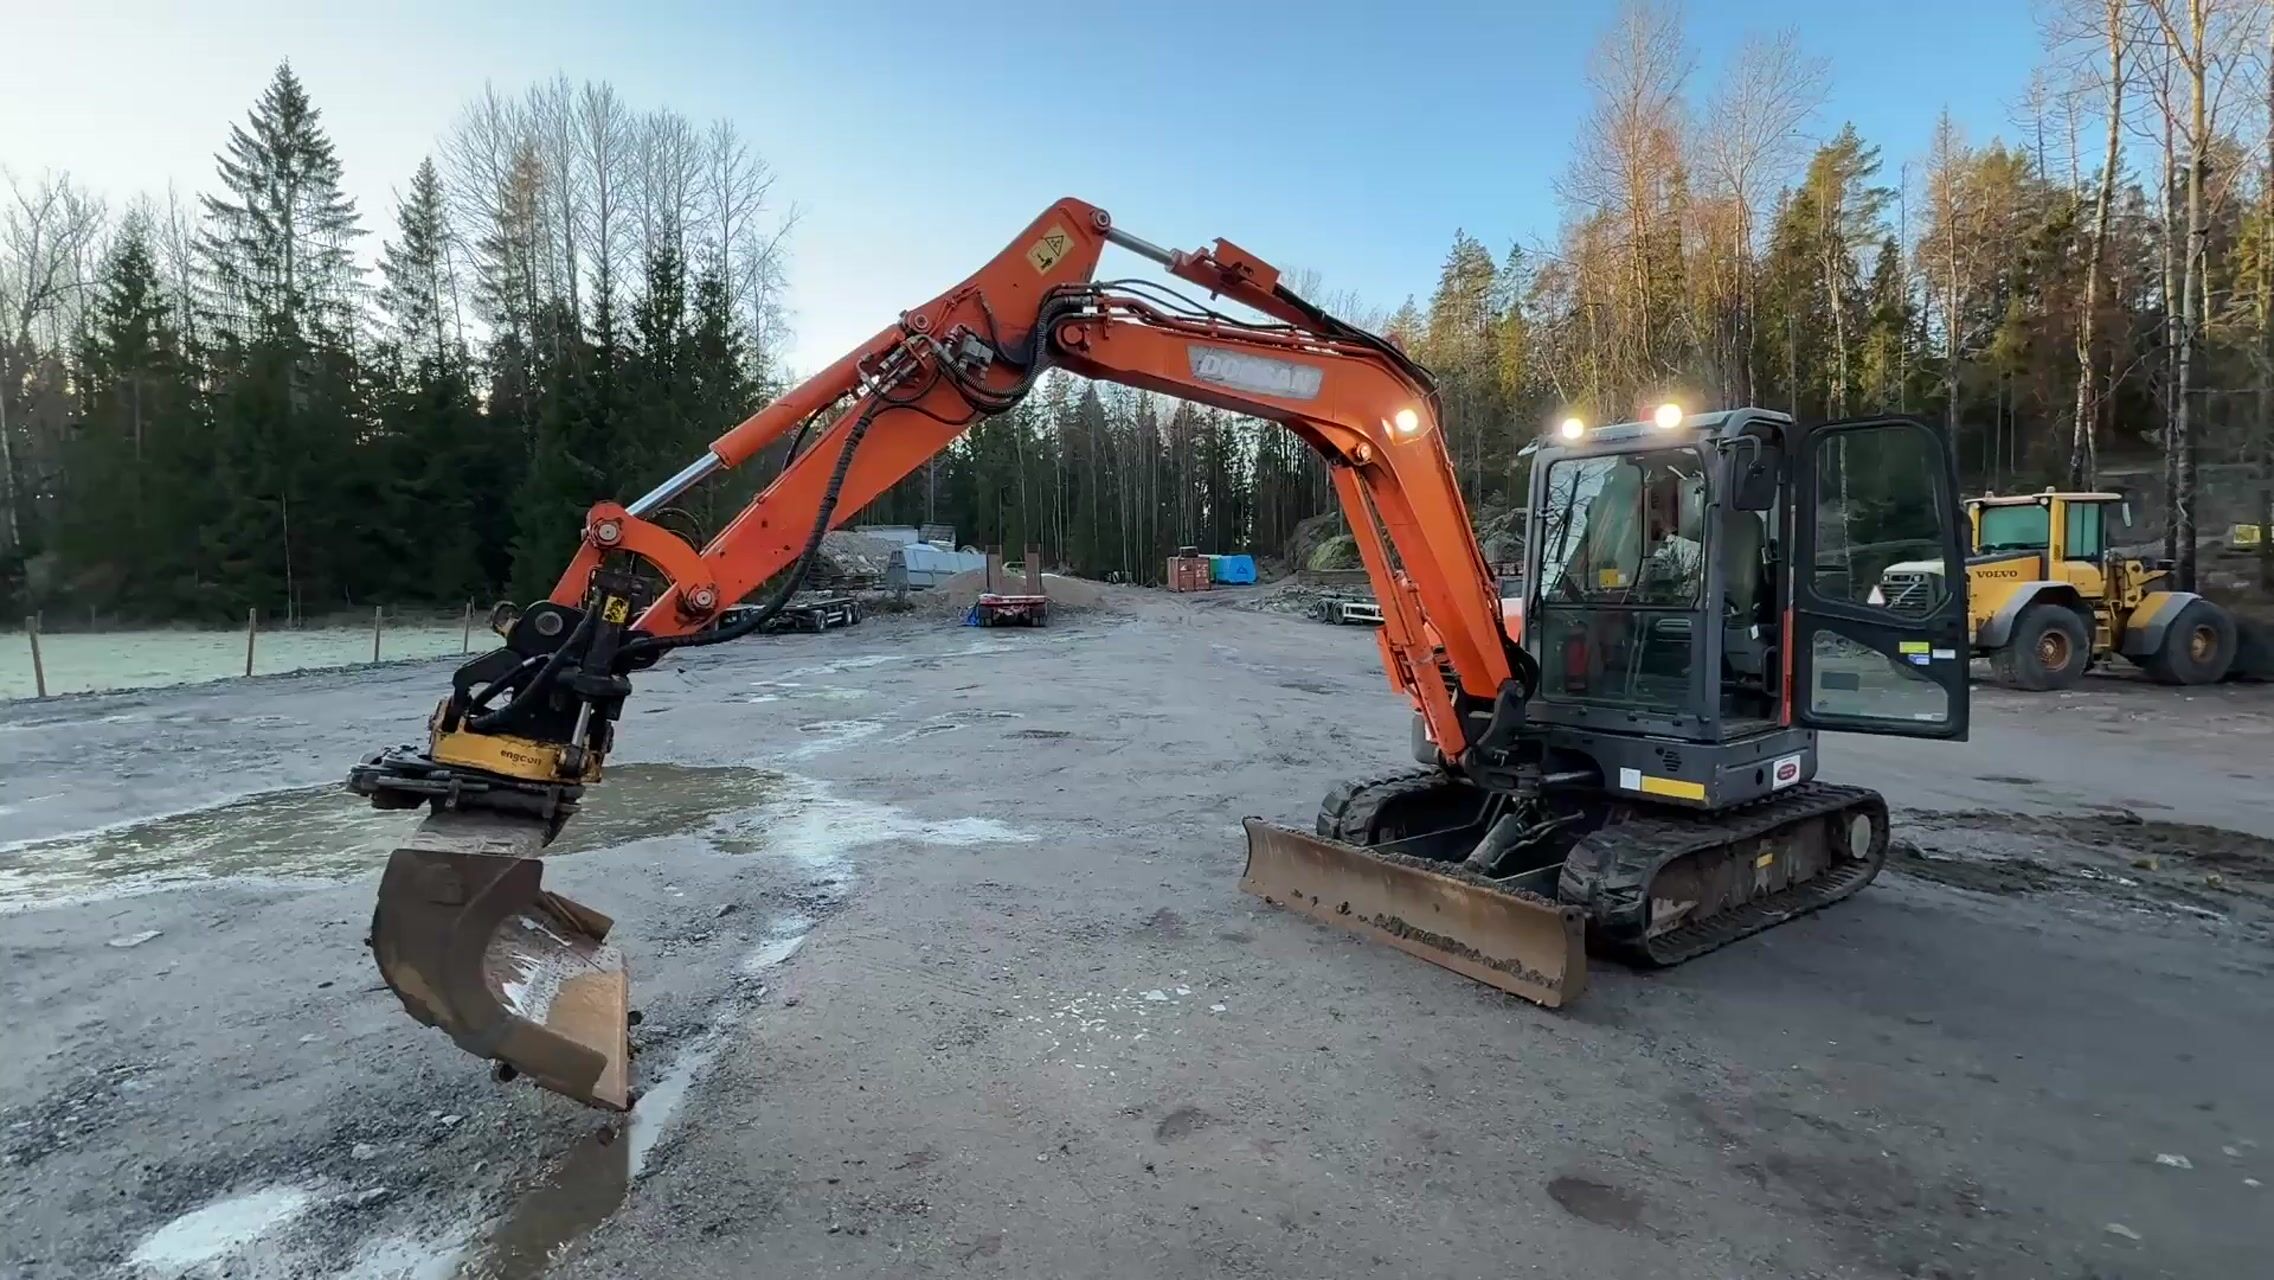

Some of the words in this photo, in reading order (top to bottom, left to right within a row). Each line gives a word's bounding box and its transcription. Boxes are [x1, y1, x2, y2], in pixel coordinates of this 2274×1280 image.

[1199, 354, 1313, 393] DOAN
[1976, 570, 2018, 578] VOLVO
[500, 748, 542, 766] engcon
